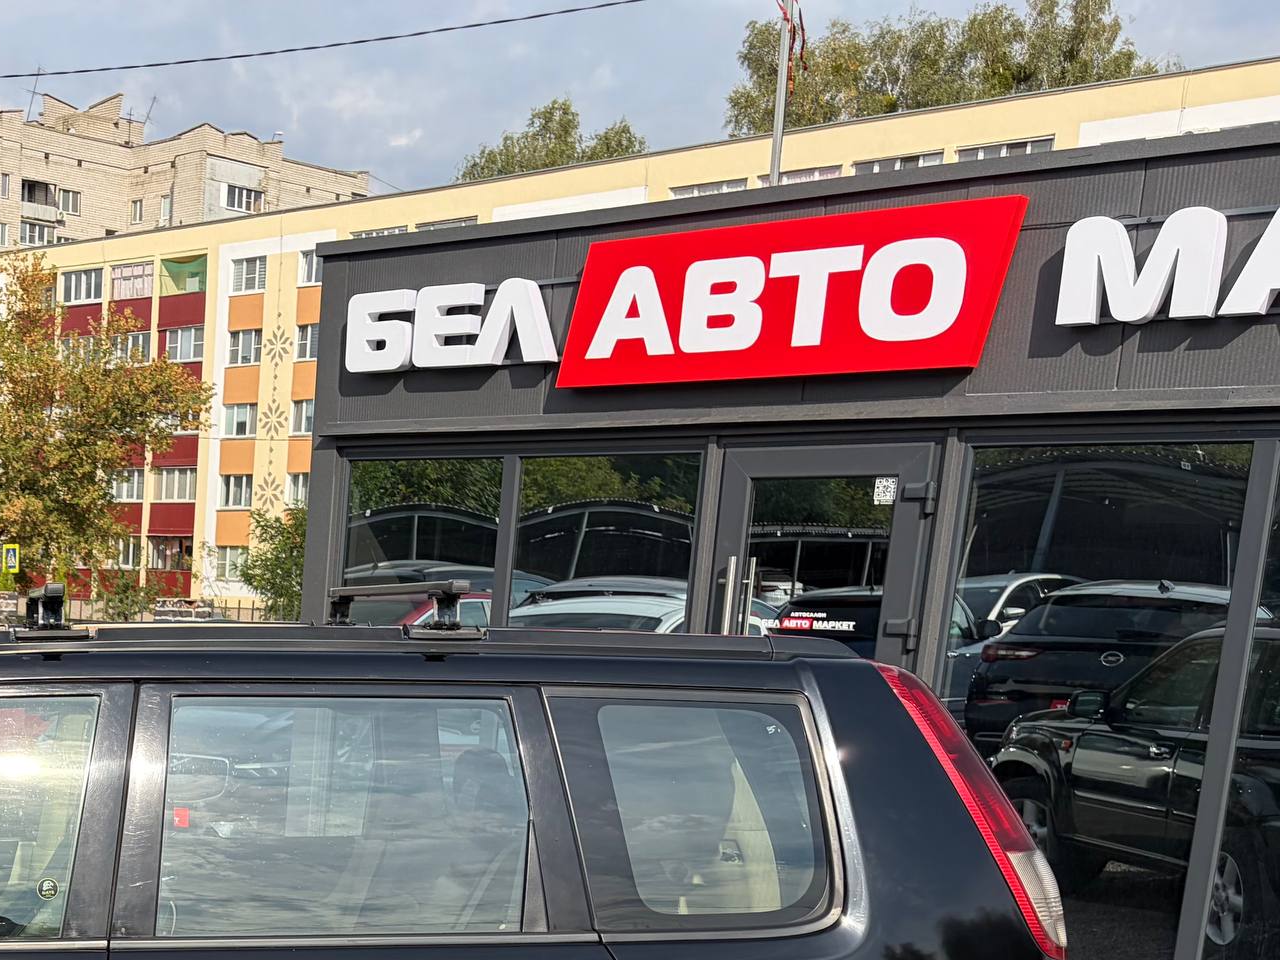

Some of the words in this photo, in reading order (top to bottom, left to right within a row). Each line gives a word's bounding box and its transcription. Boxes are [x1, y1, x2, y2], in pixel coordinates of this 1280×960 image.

[346, 277, 558, 373] БЕЛ
[584, 236, 968, 361] АВТО
[761, 618, 780, 629] БЕЛ
[782, 619, 810, 628] АВТО
[812, 620, 856, 631] МАРКЕТ
